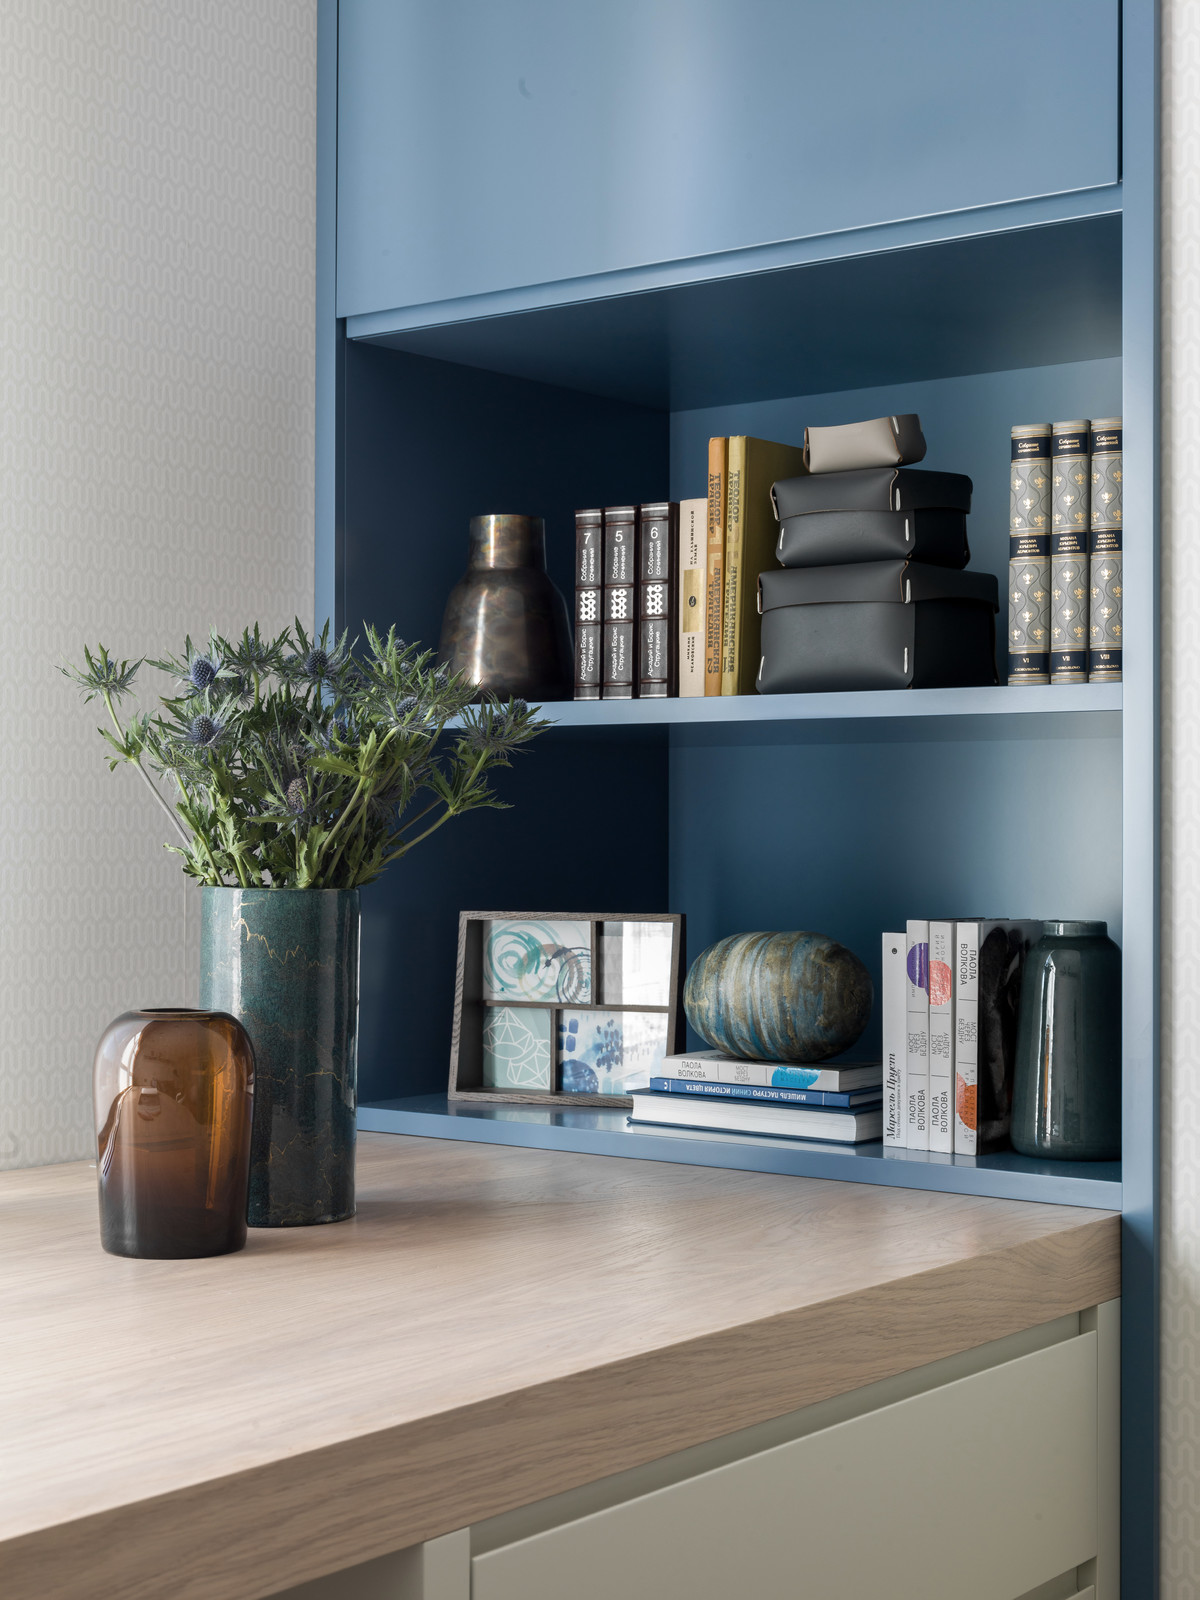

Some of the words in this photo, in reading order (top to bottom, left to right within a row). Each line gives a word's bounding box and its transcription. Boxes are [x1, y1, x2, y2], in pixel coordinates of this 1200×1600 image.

[732, 470, 740, 524] ТЕОДОР
[584, 532, 592, 544] 7
[615, 530, 623, 542] 5
[650, 526, 658, 539] 6
[728, 566, 737, 673] АМЕРИКАНСКАЯ
[678, 1069, 706, 1078] ВОЛКОВА
[886, 1053, 897, 1090] Пруст
[704, 1086, 730, 1094] ИСТОРИЯ
[731, 1088, 752, 1096] СИНИЙ
[752, 1090, 778, 1098] ПАСТУРО
[886, 1093, 896, 1139] Марсель
